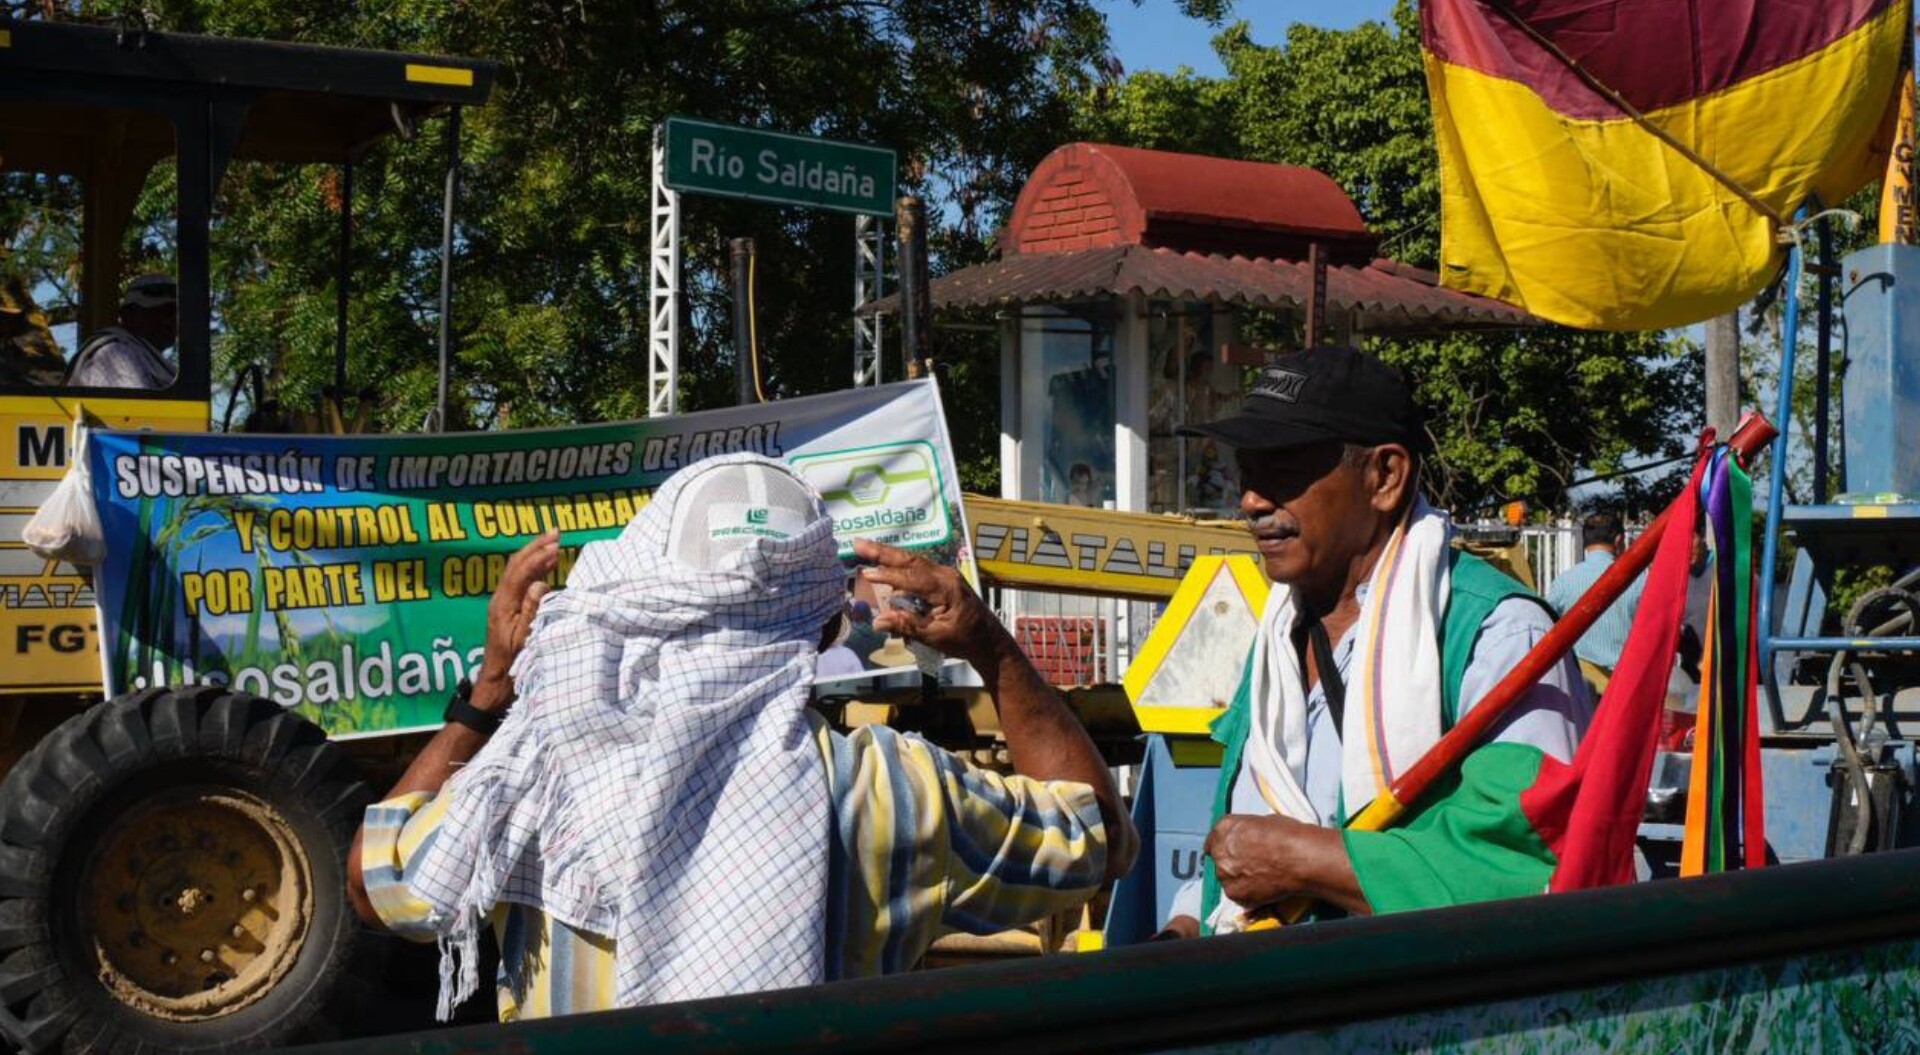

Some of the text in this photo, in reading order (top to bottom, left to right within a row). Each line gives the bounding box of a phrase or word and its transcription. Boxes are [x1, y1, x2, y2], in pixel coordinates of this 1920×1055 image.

[691, 138, 875, 198] Río Saldaña
[115, 449, 324, 499] SUSPENSIÓN
[335, 455, 376, 492] DE
[388, 441, 634, 489] IMPORTACIONES
[643, 434, 682, 472] DE
[233, 508, 256, 553] Y
[269, 503, 418, 551] CONTROL
[427, 501, 466, 541] AL
[183, 569, 251, 616] POR
[263, 562, 364, 610] PARTE
[374, 559, 431, 603] DEL
